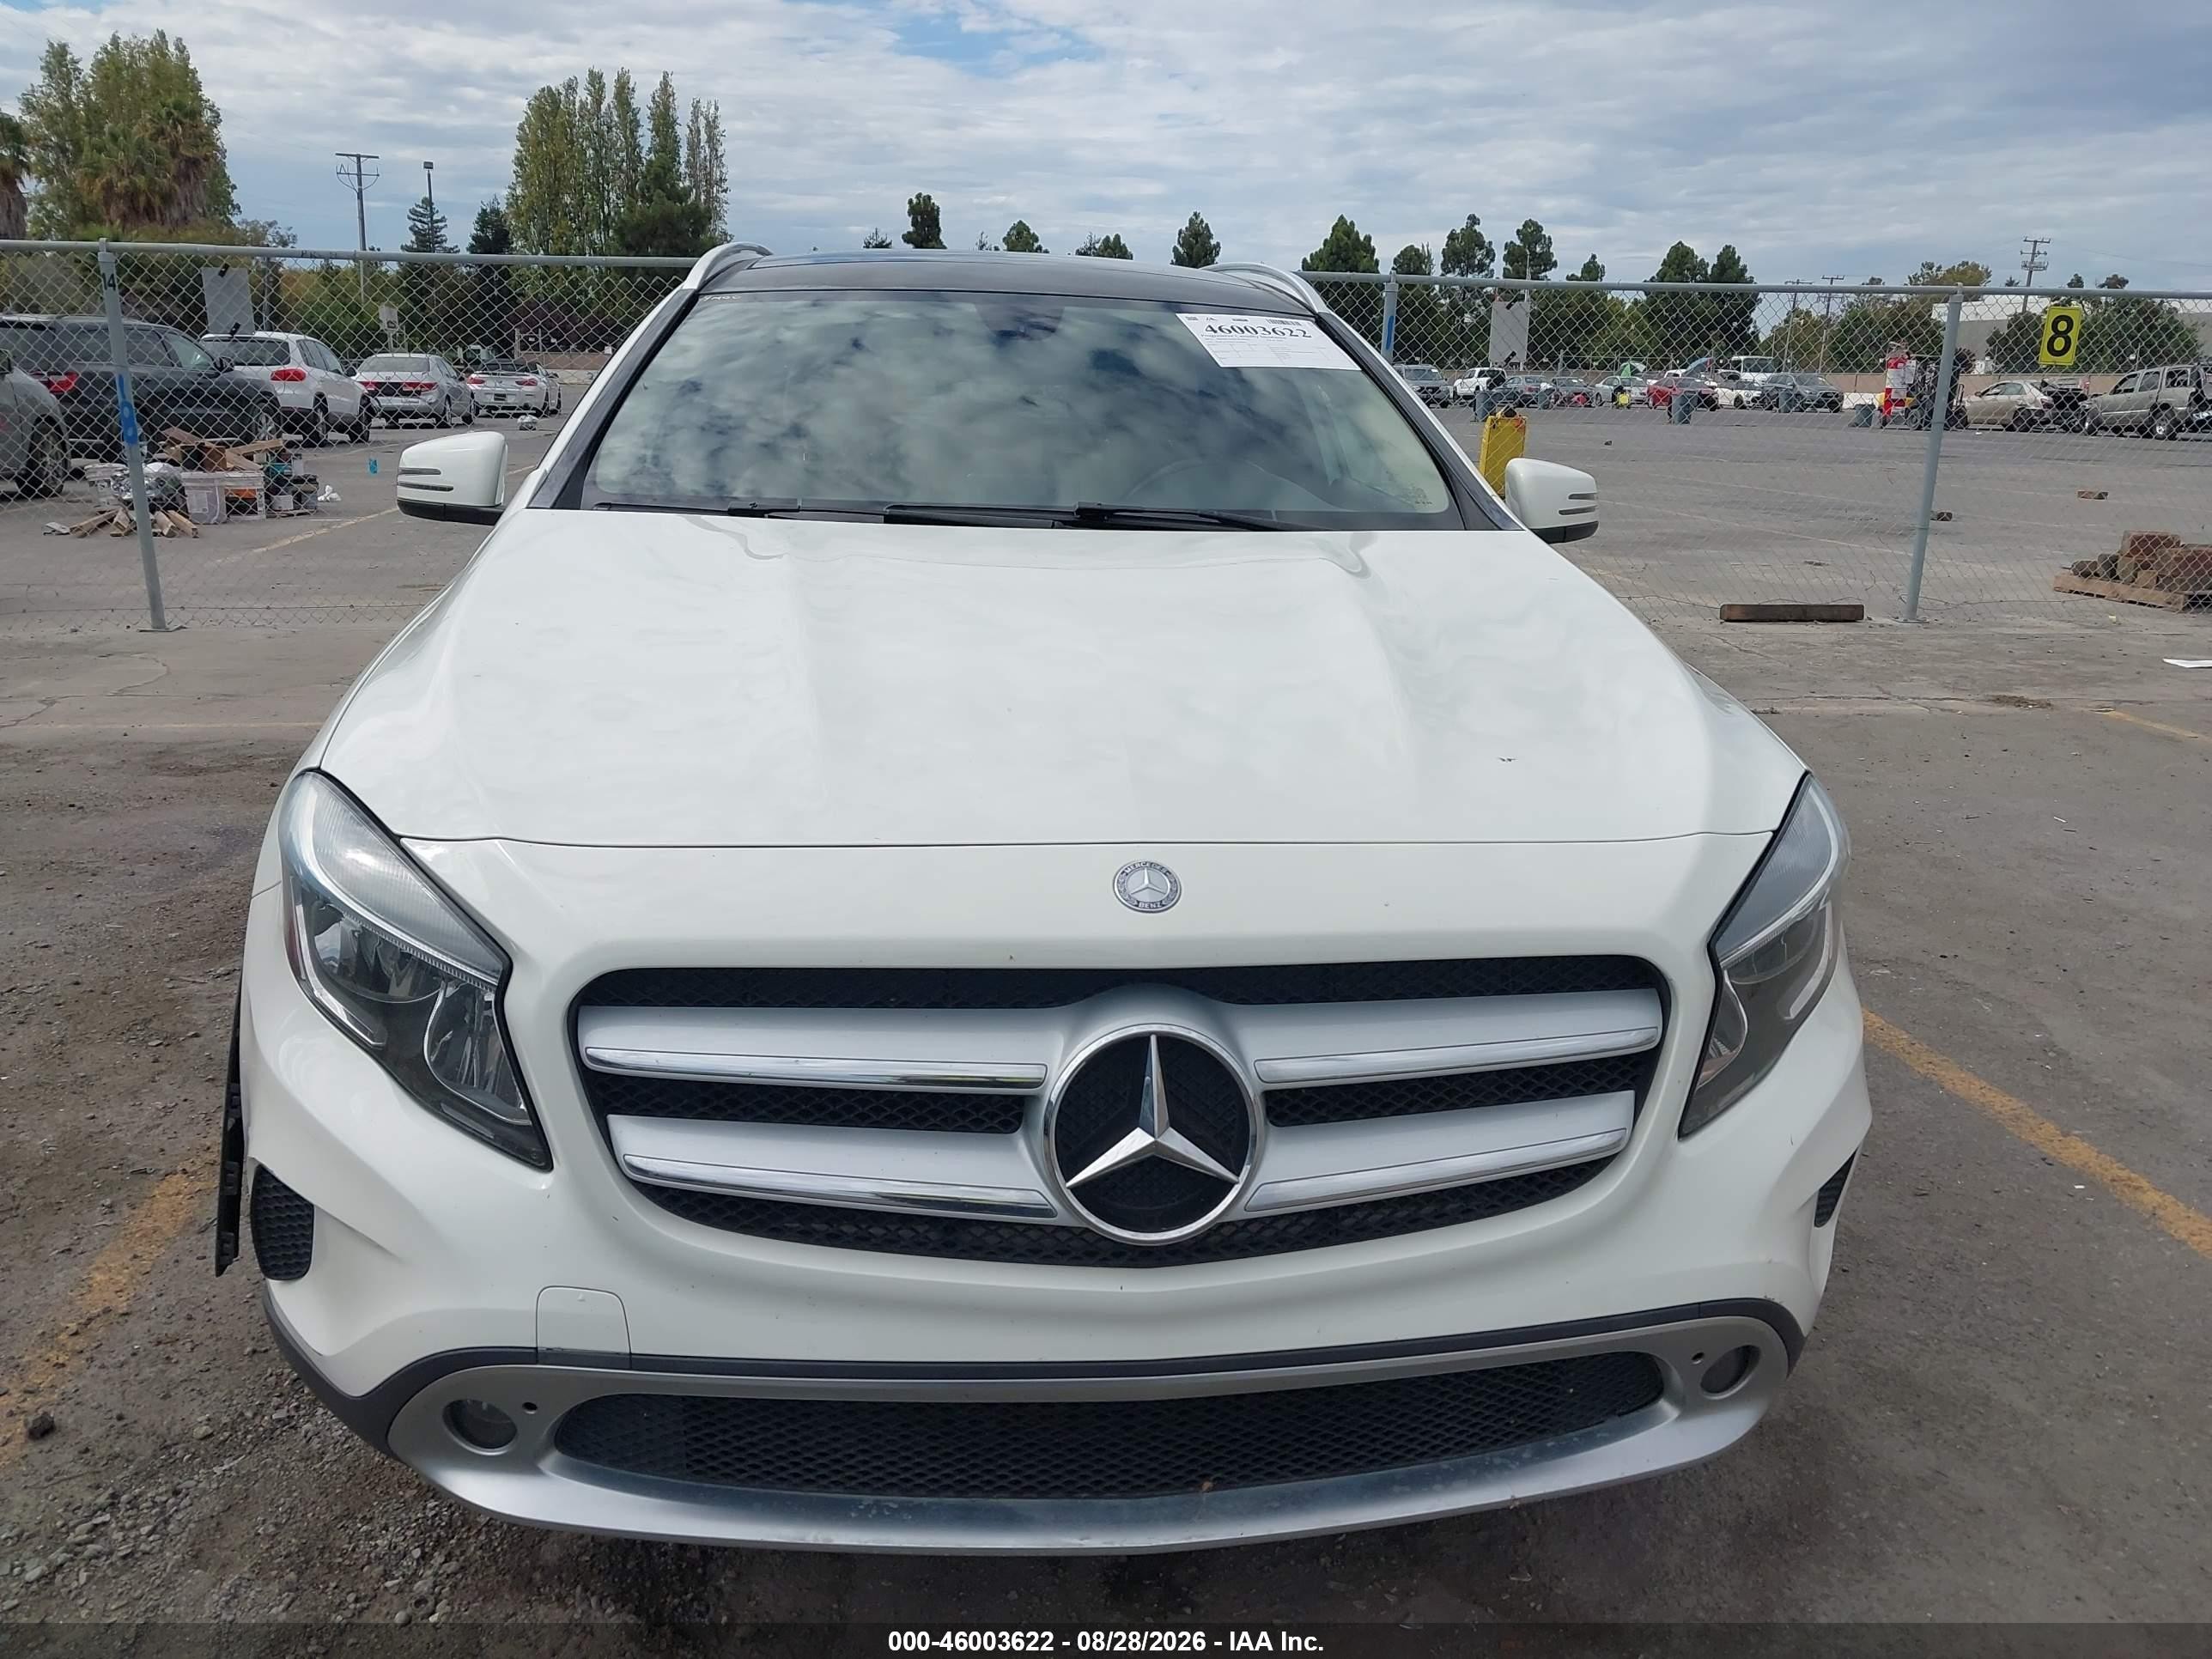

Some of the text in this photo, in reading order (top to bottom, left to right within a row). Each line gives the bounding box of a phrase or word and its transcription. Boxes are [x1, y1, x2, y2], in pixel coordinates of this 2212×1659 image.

[101, 272, 116, 291] 14
[1205, 324, 1313, 338] 46003622
[2047, 314, 2075, 357] 8
